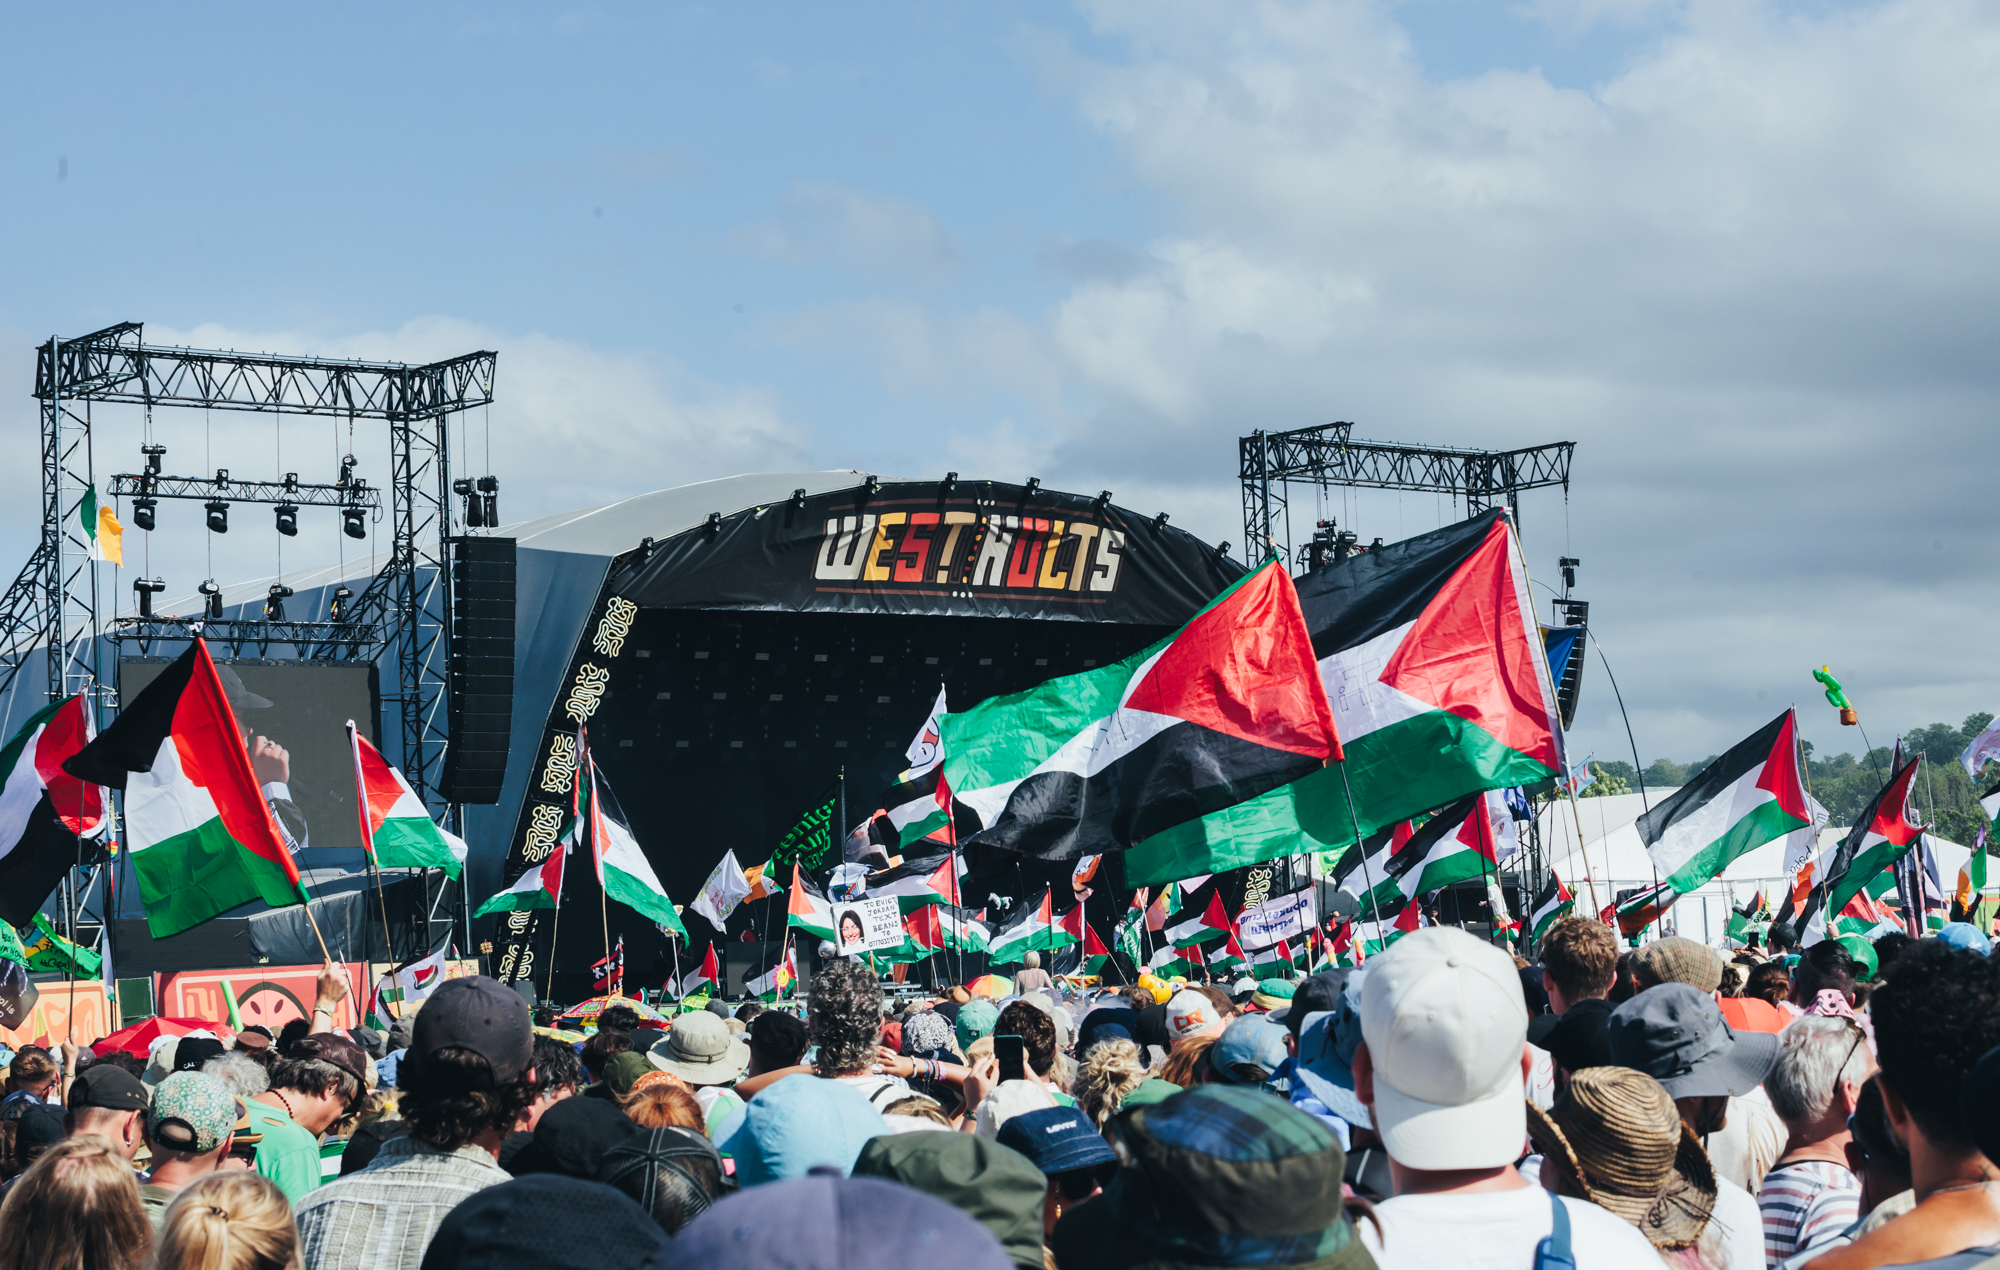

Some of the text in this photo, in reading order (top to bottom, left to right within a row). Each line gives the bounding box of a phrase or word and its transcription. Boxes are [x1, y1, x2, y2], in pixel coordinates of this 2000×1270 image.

[814, 511, 977, 584] WEST
[864, 897, 898, 909] TO EVICT
[868, 905, 895, 916] JORDAN
[873, 911, 897, 922] TEXT
[873, 920, 898, 932] BEANS
[1173, 1008, 1206, 1032] CR
